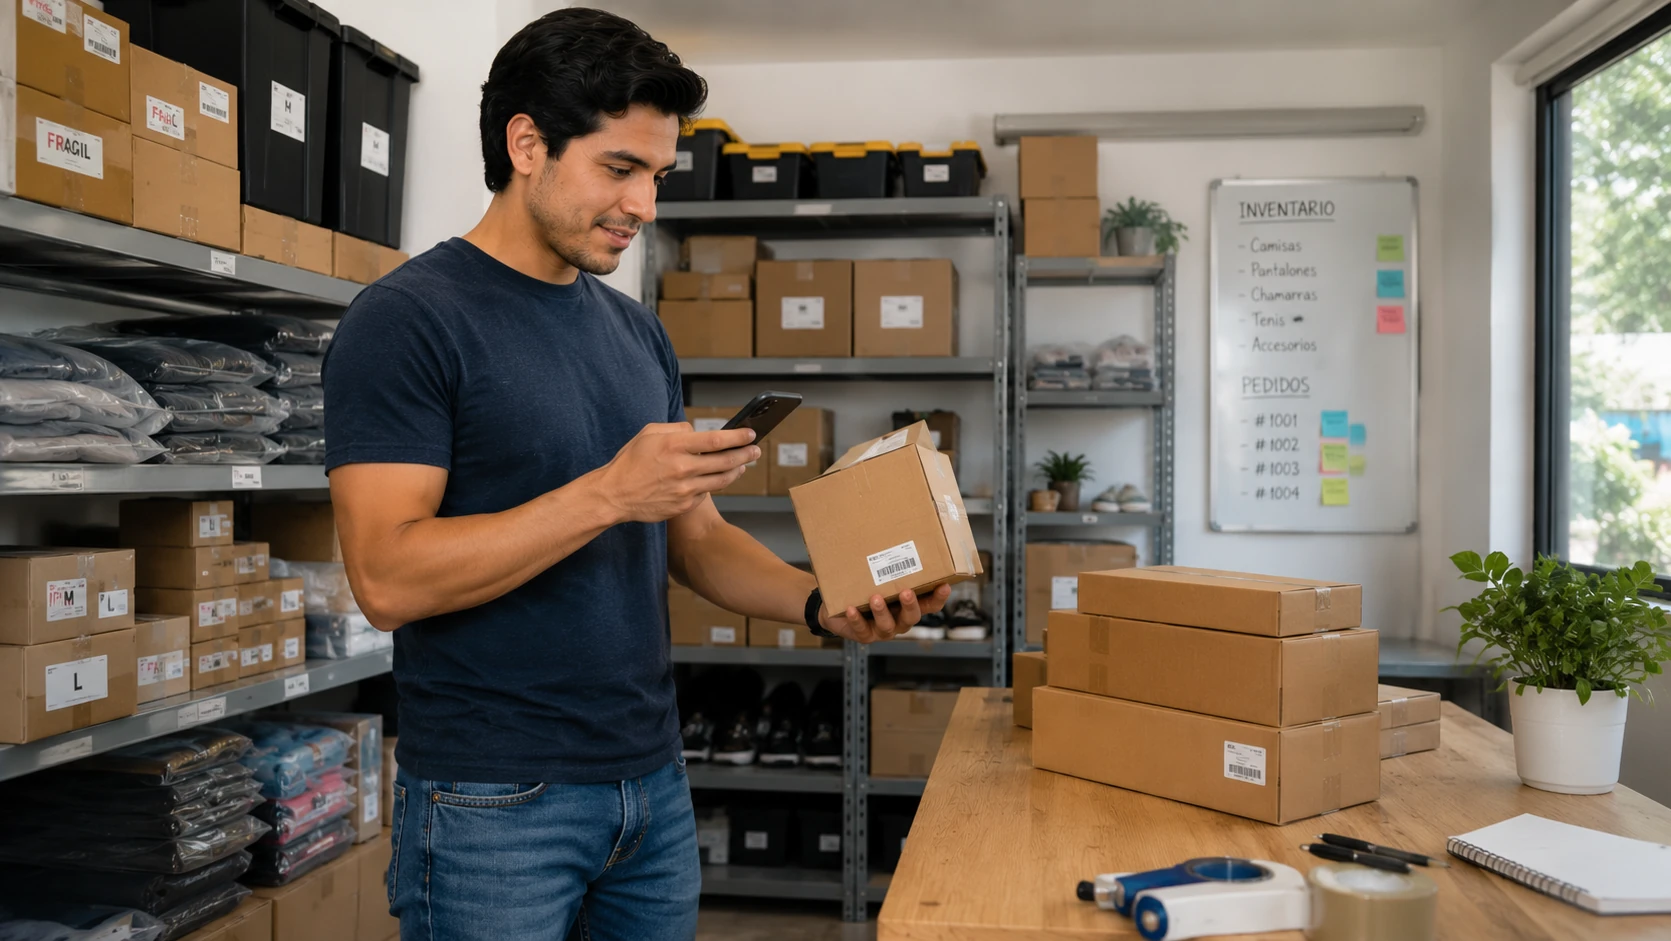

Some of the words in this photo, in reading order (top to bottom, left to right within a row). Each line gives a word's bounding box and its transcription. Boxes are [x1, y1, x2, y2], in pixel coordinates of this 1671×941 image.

[1239, 200, 1335, 218] INVENTARIO
[1250, 237, 1302, 252] Camisas
[1251, 262, 1317, 277] Pantalones
[1251, 287, 1318, 301] Chamarras
[1252, 312, 1285, 327] Tenis
[1252, 337, 1317, 352] Accesorios
[1242, 376, 1310, 394] PEDIDOS
[74, 672, 82, 691] L
